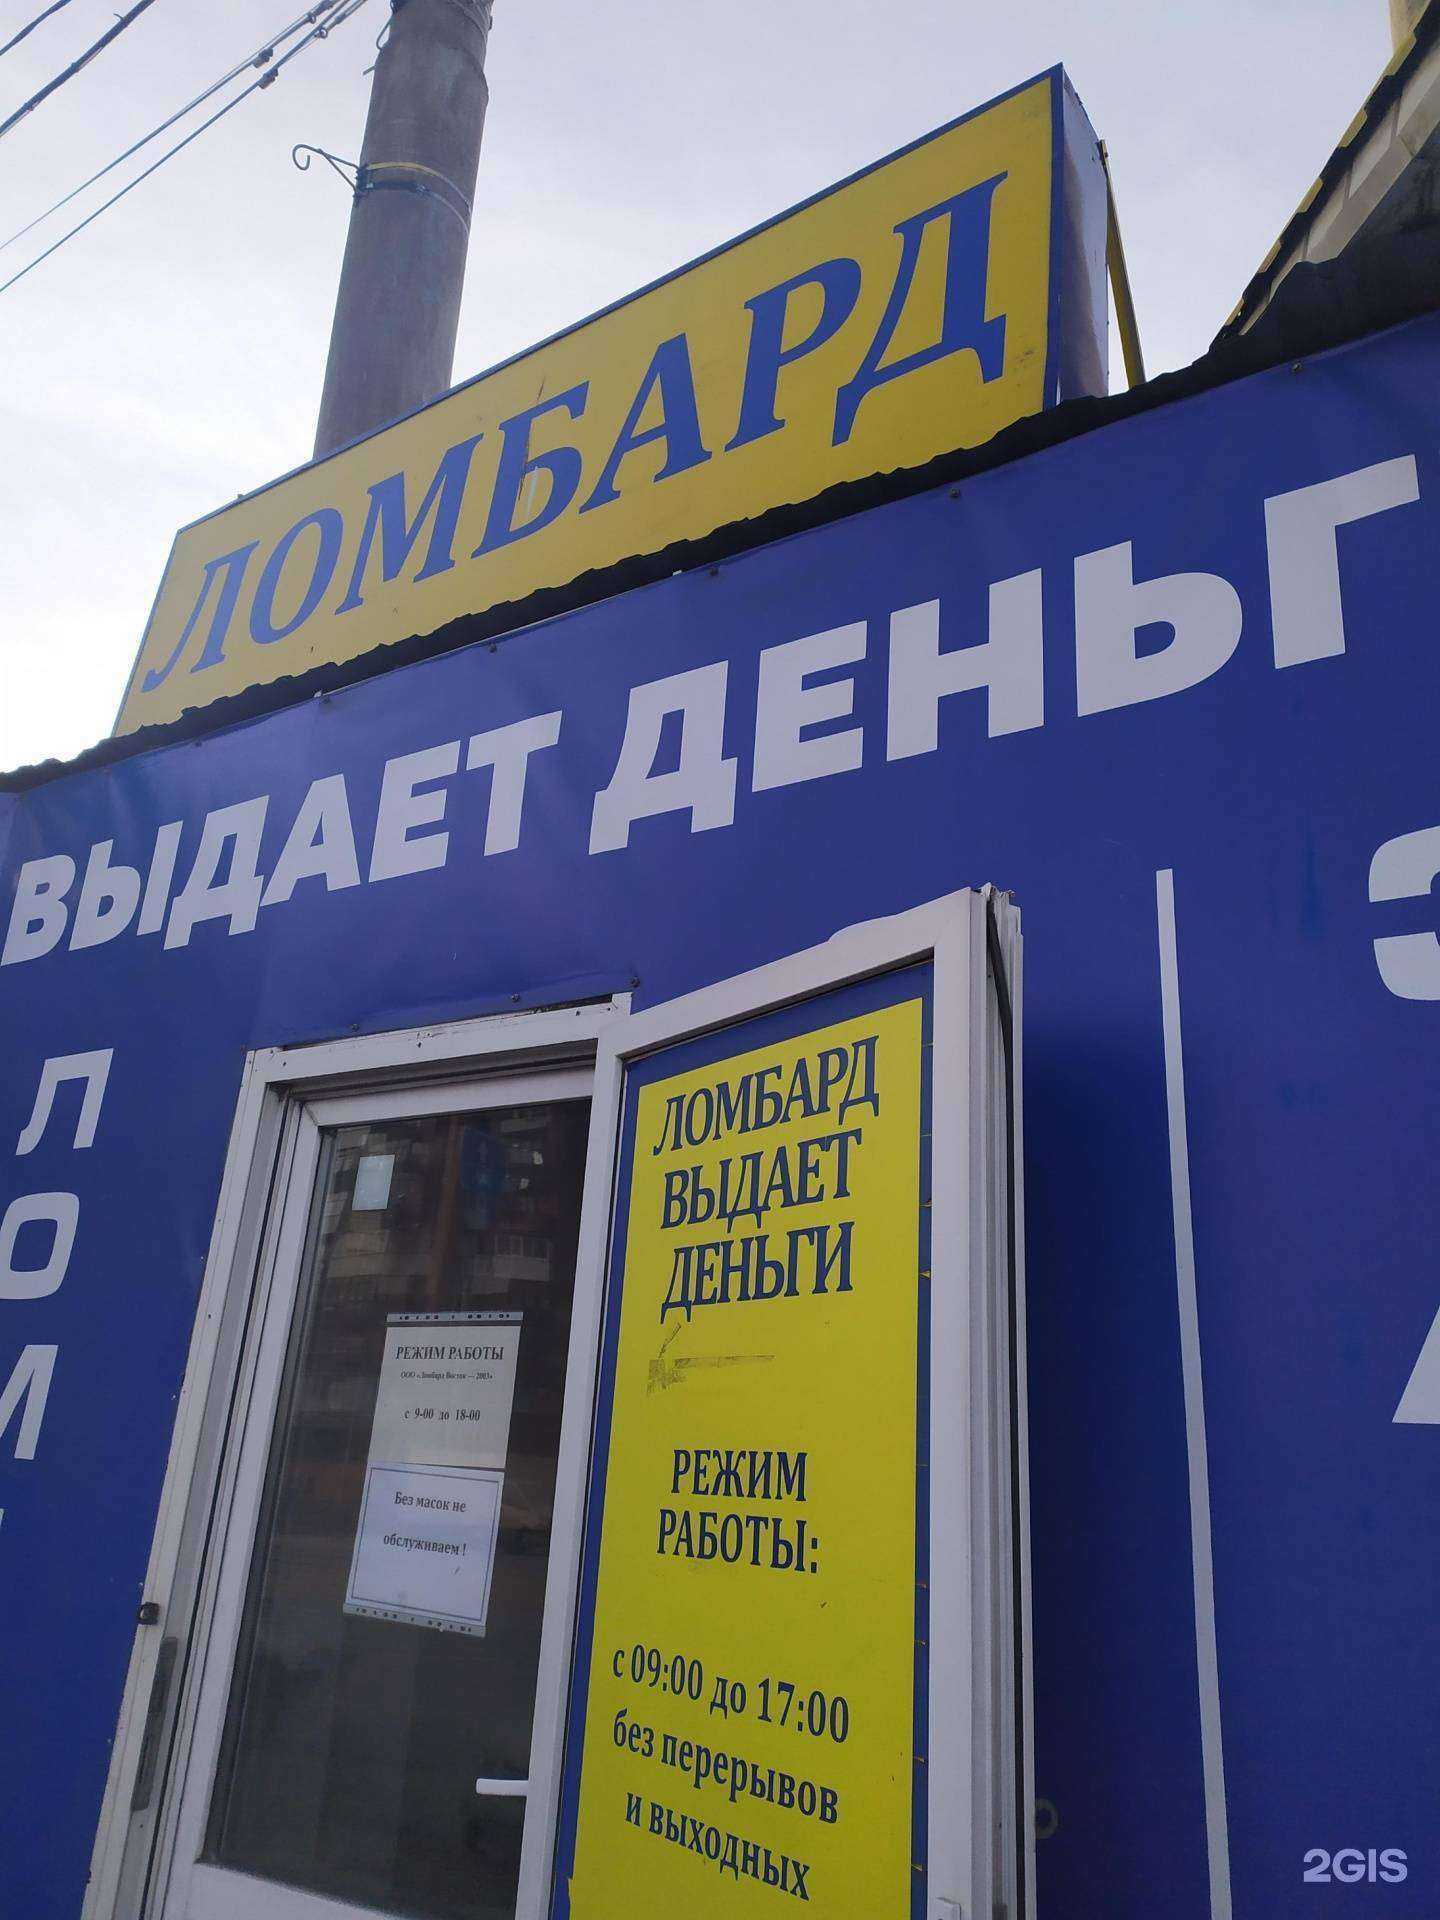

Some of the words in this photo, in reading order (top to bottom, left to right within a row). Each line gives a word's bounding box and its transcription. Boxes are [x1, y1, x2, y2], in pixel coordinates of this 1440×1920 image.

[142, 171, 1008, 692] ЛОМБАРД
[0, 711, 562, 966] ВЫДАЕТ
[588, 454, 1420, 855] ДЕНЬГ
[653, 1035, 880, 1156] ЛОМБАРД
[660, 1128, 863, 1233] ВЫДАЕТ
[660, 1222, 855, 1325] ДЕНЬГИ
[396, 1346, 446, 1360] РЕЖИМ
[448, 1346, 504, 1360] РАБОТЫ
[404, 1410, 410, 1419] с
[414, 1407, 434, 1419] 9-00
[439, 1411, 450, 1421] до
[455, 1409, 481, 1421] 18-00
[394, 1491, 414, 1506] Без
[415, 1497, 450, 1511] масок
[452, 1501, 467, 1513] не
[671, 1449, 808, 1502] РЕЖИМ
[656, 1509, 820, 1574] РАБОТЫ:
[612, 1648, 625, 1678] с
[630, 1644, 704, 1701] 09:00
[709, 1675, 747, 1720] до
[757, 1677, 850, 1743] 17:00
[612, 1707, 655, 1758] без
[661, 1733, 839, 1825] перерывов
[625, 1792, 643, 1827] и
[648, 1800, 811, 1901] выходных
